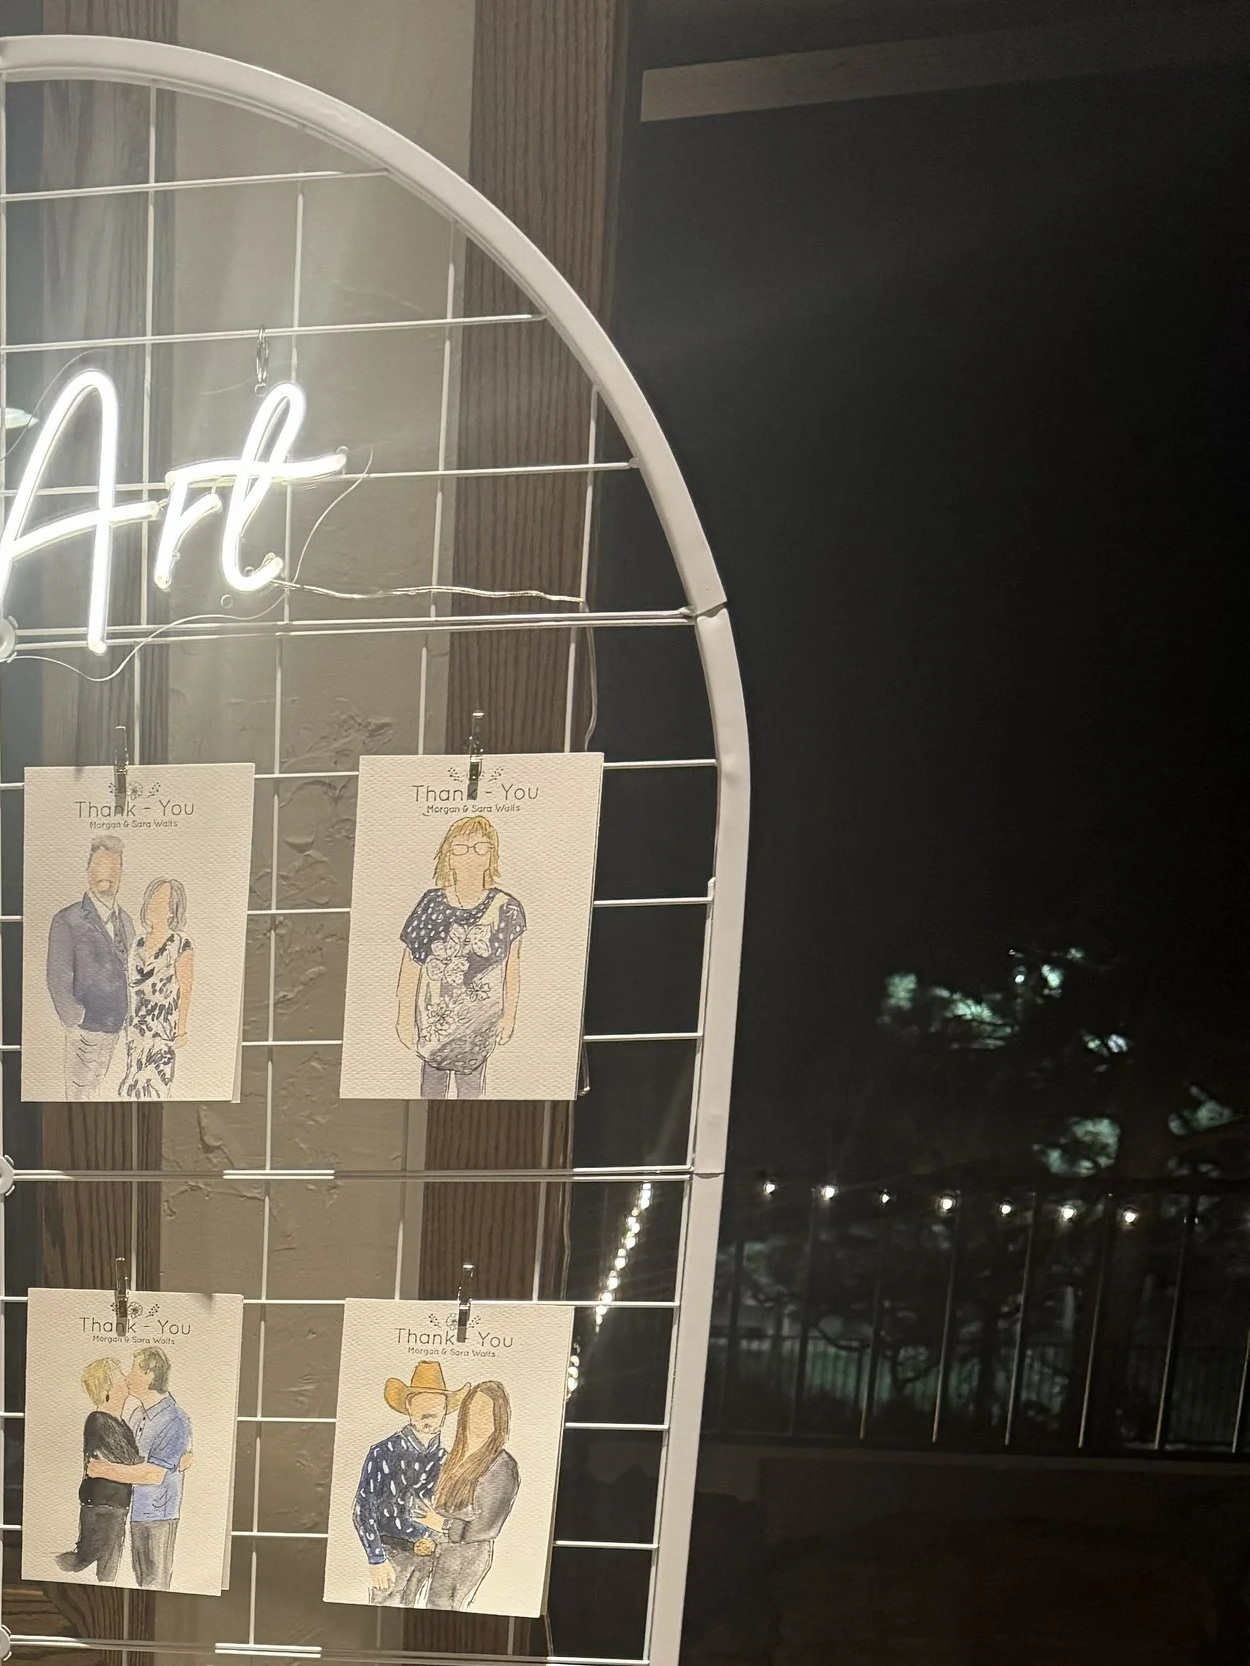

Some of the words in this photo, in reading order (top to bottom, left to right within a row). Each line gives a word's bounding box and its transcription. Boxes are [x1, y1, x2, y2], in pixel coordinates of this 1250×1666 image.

[411, 784, 478, 802] Thank
[501, 783, 539, 801] You
[74, 800, 136, 818] Thank
[159, 799, 194, 817] You
[426, 804, 460, 815] Morgan
[471, 804, 492, 813] Sara
[90, 821, 121, 830] Morgan
[131, 820, 151, 828] Sara
[79, 1317, 136, 1333] Thank
[157, 1319, 191, 1335] You
[92, 1335, 123, 1344] Morgan
[131, 1335, 151, 1344] Sara
[395, 1327, 454, 1346] Thank
[478, 1331, 513, 1348] You
[407, 1346, 439, 1356] Morgan
[449, 1347, 470, 1357] Sara
